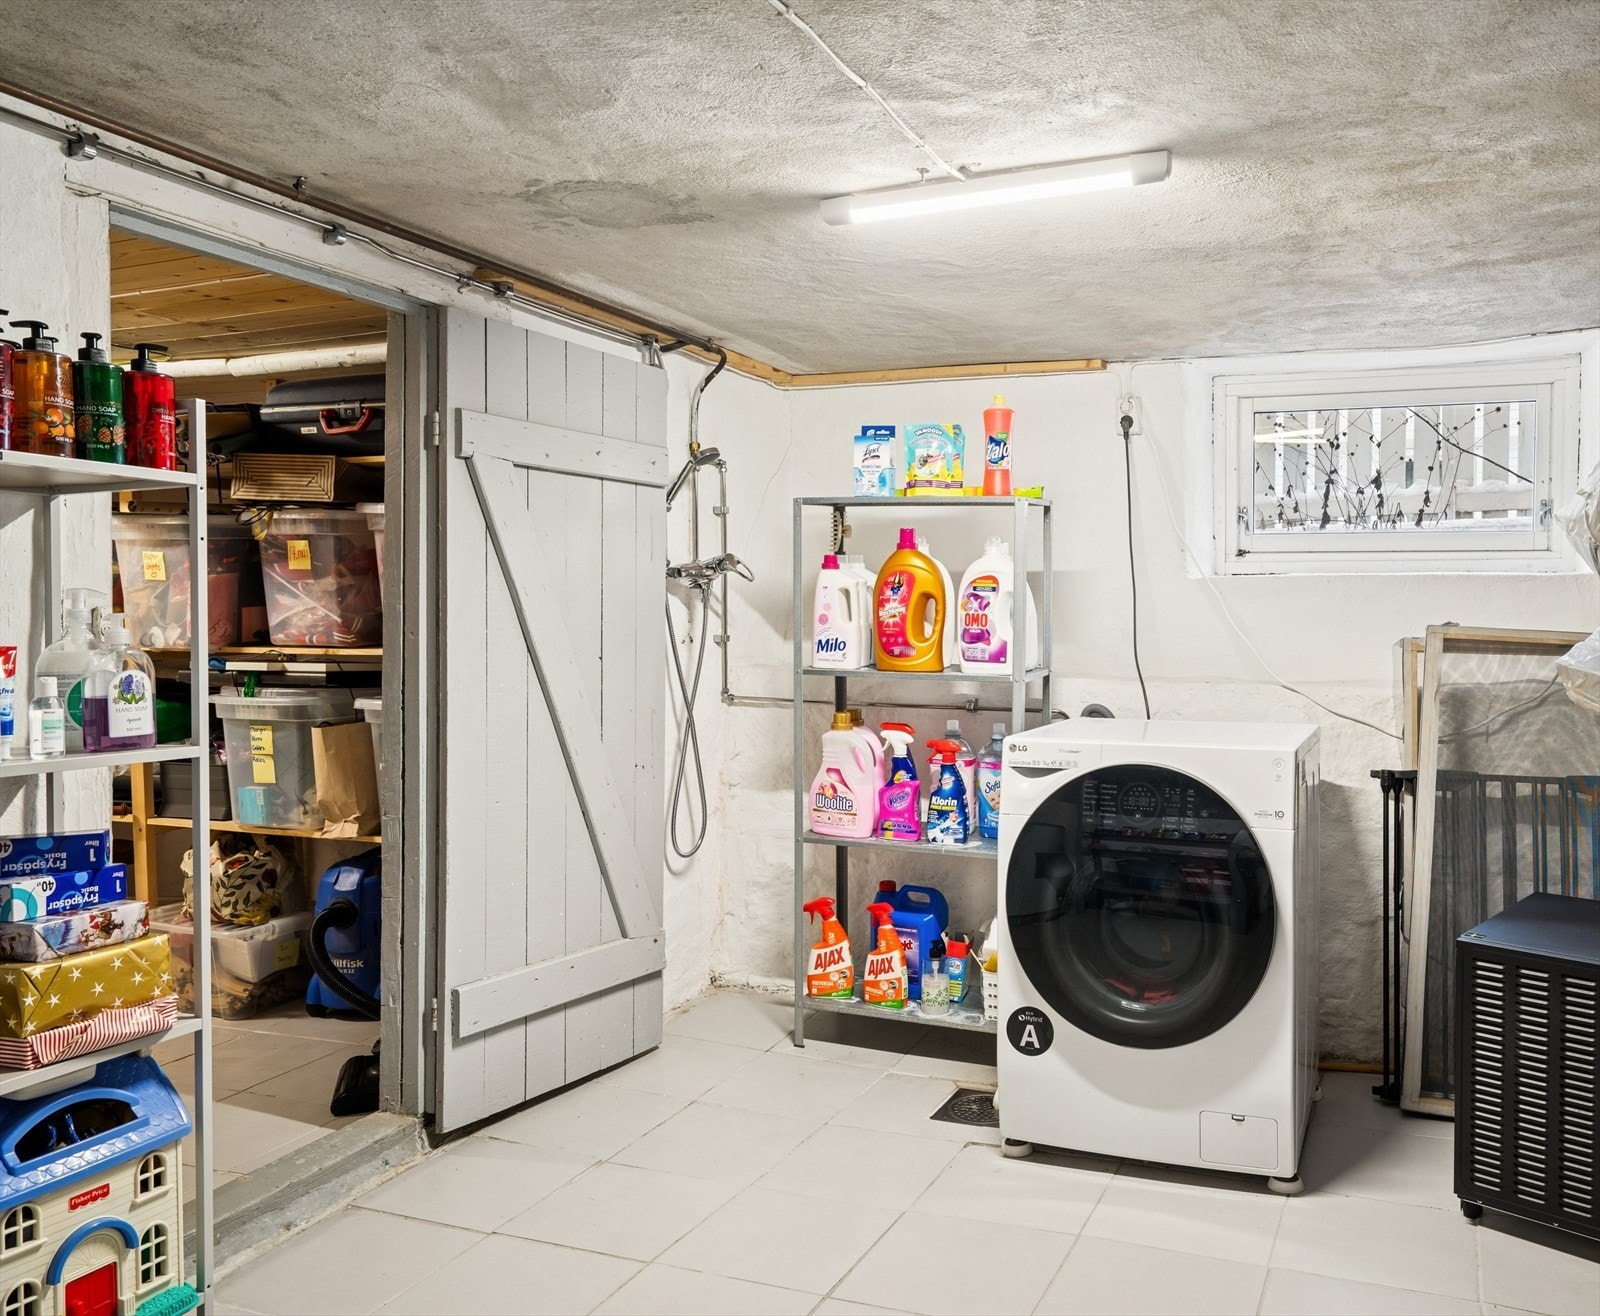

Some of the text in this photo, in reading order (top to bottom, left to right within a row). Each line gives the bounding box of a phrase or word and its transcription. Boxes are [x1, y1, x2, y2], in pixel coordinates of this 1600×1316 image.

[45, 396, 64, 404] HAND
[986, 442, 1010, 461] Zalo
[964, 613, 988, 628] OMO
[816, 637, 847, 654] Milo
[816, 792, 853, 811] Woolite
[931, 795, 958, 806] Klorin
[89, 848, 97, 862] 1
[2, 859, 67, 874] Fryspåsar
[41, 880, 55, 892] 40
[80, 885, 99, 894] Basic
[115, 879, 122, 893] 1
[47, 893, 99, 910] Fryspåsar
[814, 946, 846, 973] AJAX
[867, 956, 895, 980] AJAX
[1025, 1015, 1043, 1023] Hybrid
[1019, 1024, 1041, 1049] A
